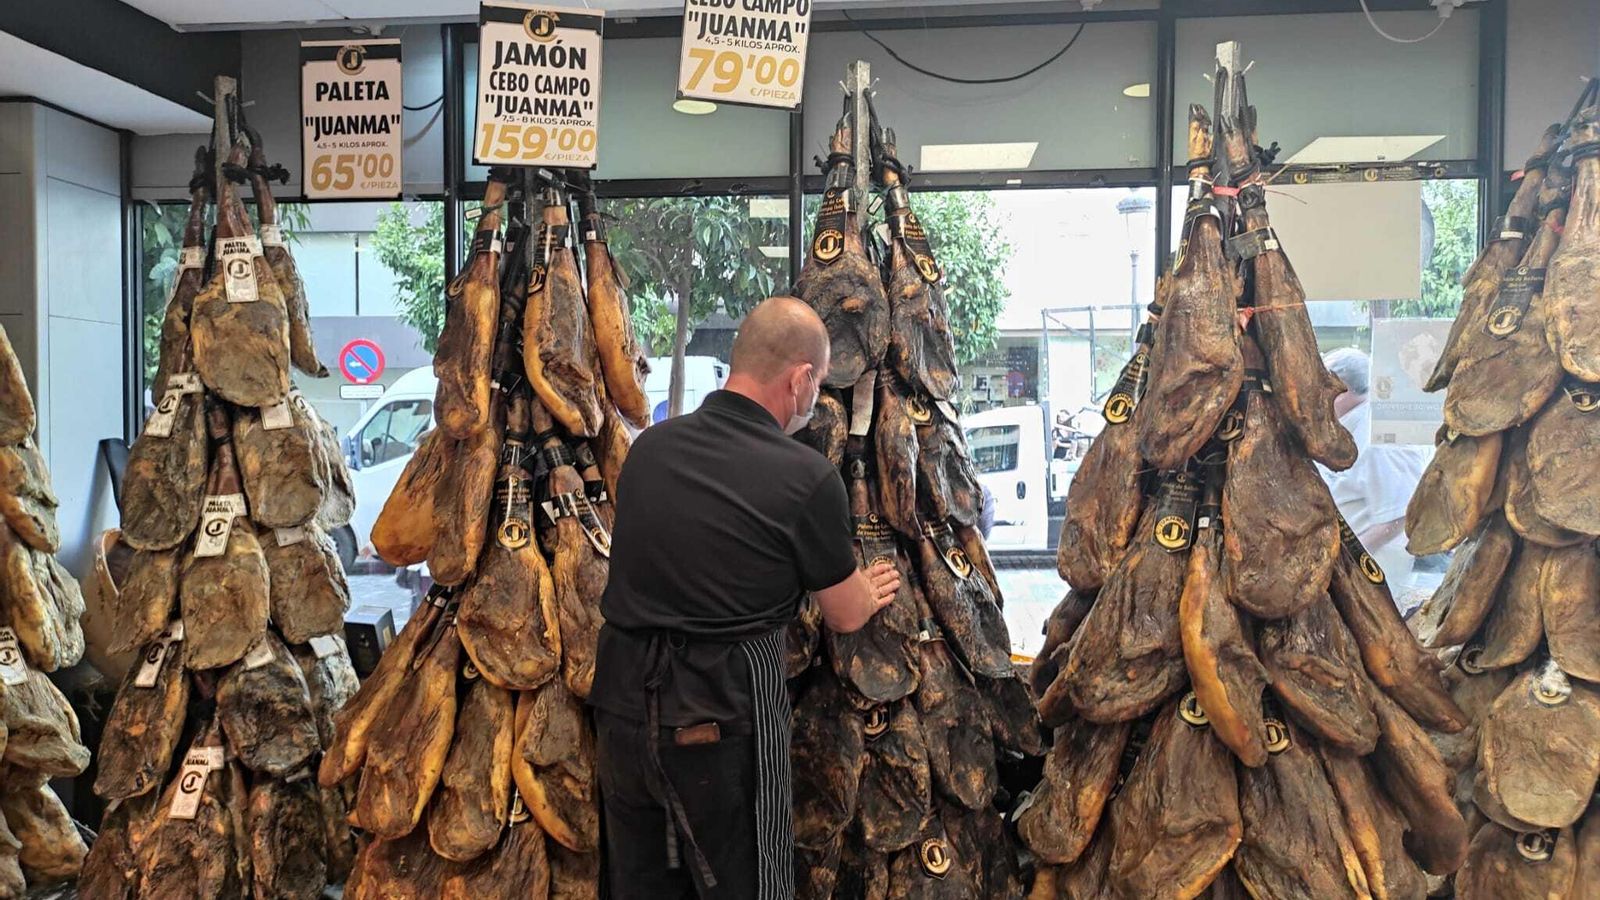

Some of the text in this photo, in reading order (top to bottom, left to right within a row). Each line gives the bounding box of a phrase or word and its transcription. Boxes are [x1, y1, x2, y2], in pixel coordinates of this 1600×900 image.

[688, 11, 806, 43] "JUANMA"
[492, 40, 586, 70] JAMÓN
[705, 37, 720, 46] 4,5
[734, 40, 762, 49] KILOS
[764, 43, 800, 53] APROX.
[315, 81, 390, 102] PALETA
[490, 71, 590, 97] CEBO CAMPO
[750, 87, 796, 100] €/PIEZA
[485, 94, 593, 118] "JUANMA"
[305, 114, 400, 141] "JUANMA"
[530, 117, 558, 125] KILOS
[559, 119, 595, 127] APROX.
[544, 153, 590, 161] €/PIEZA
[361, 181, 398, 190] €/PIEZA
